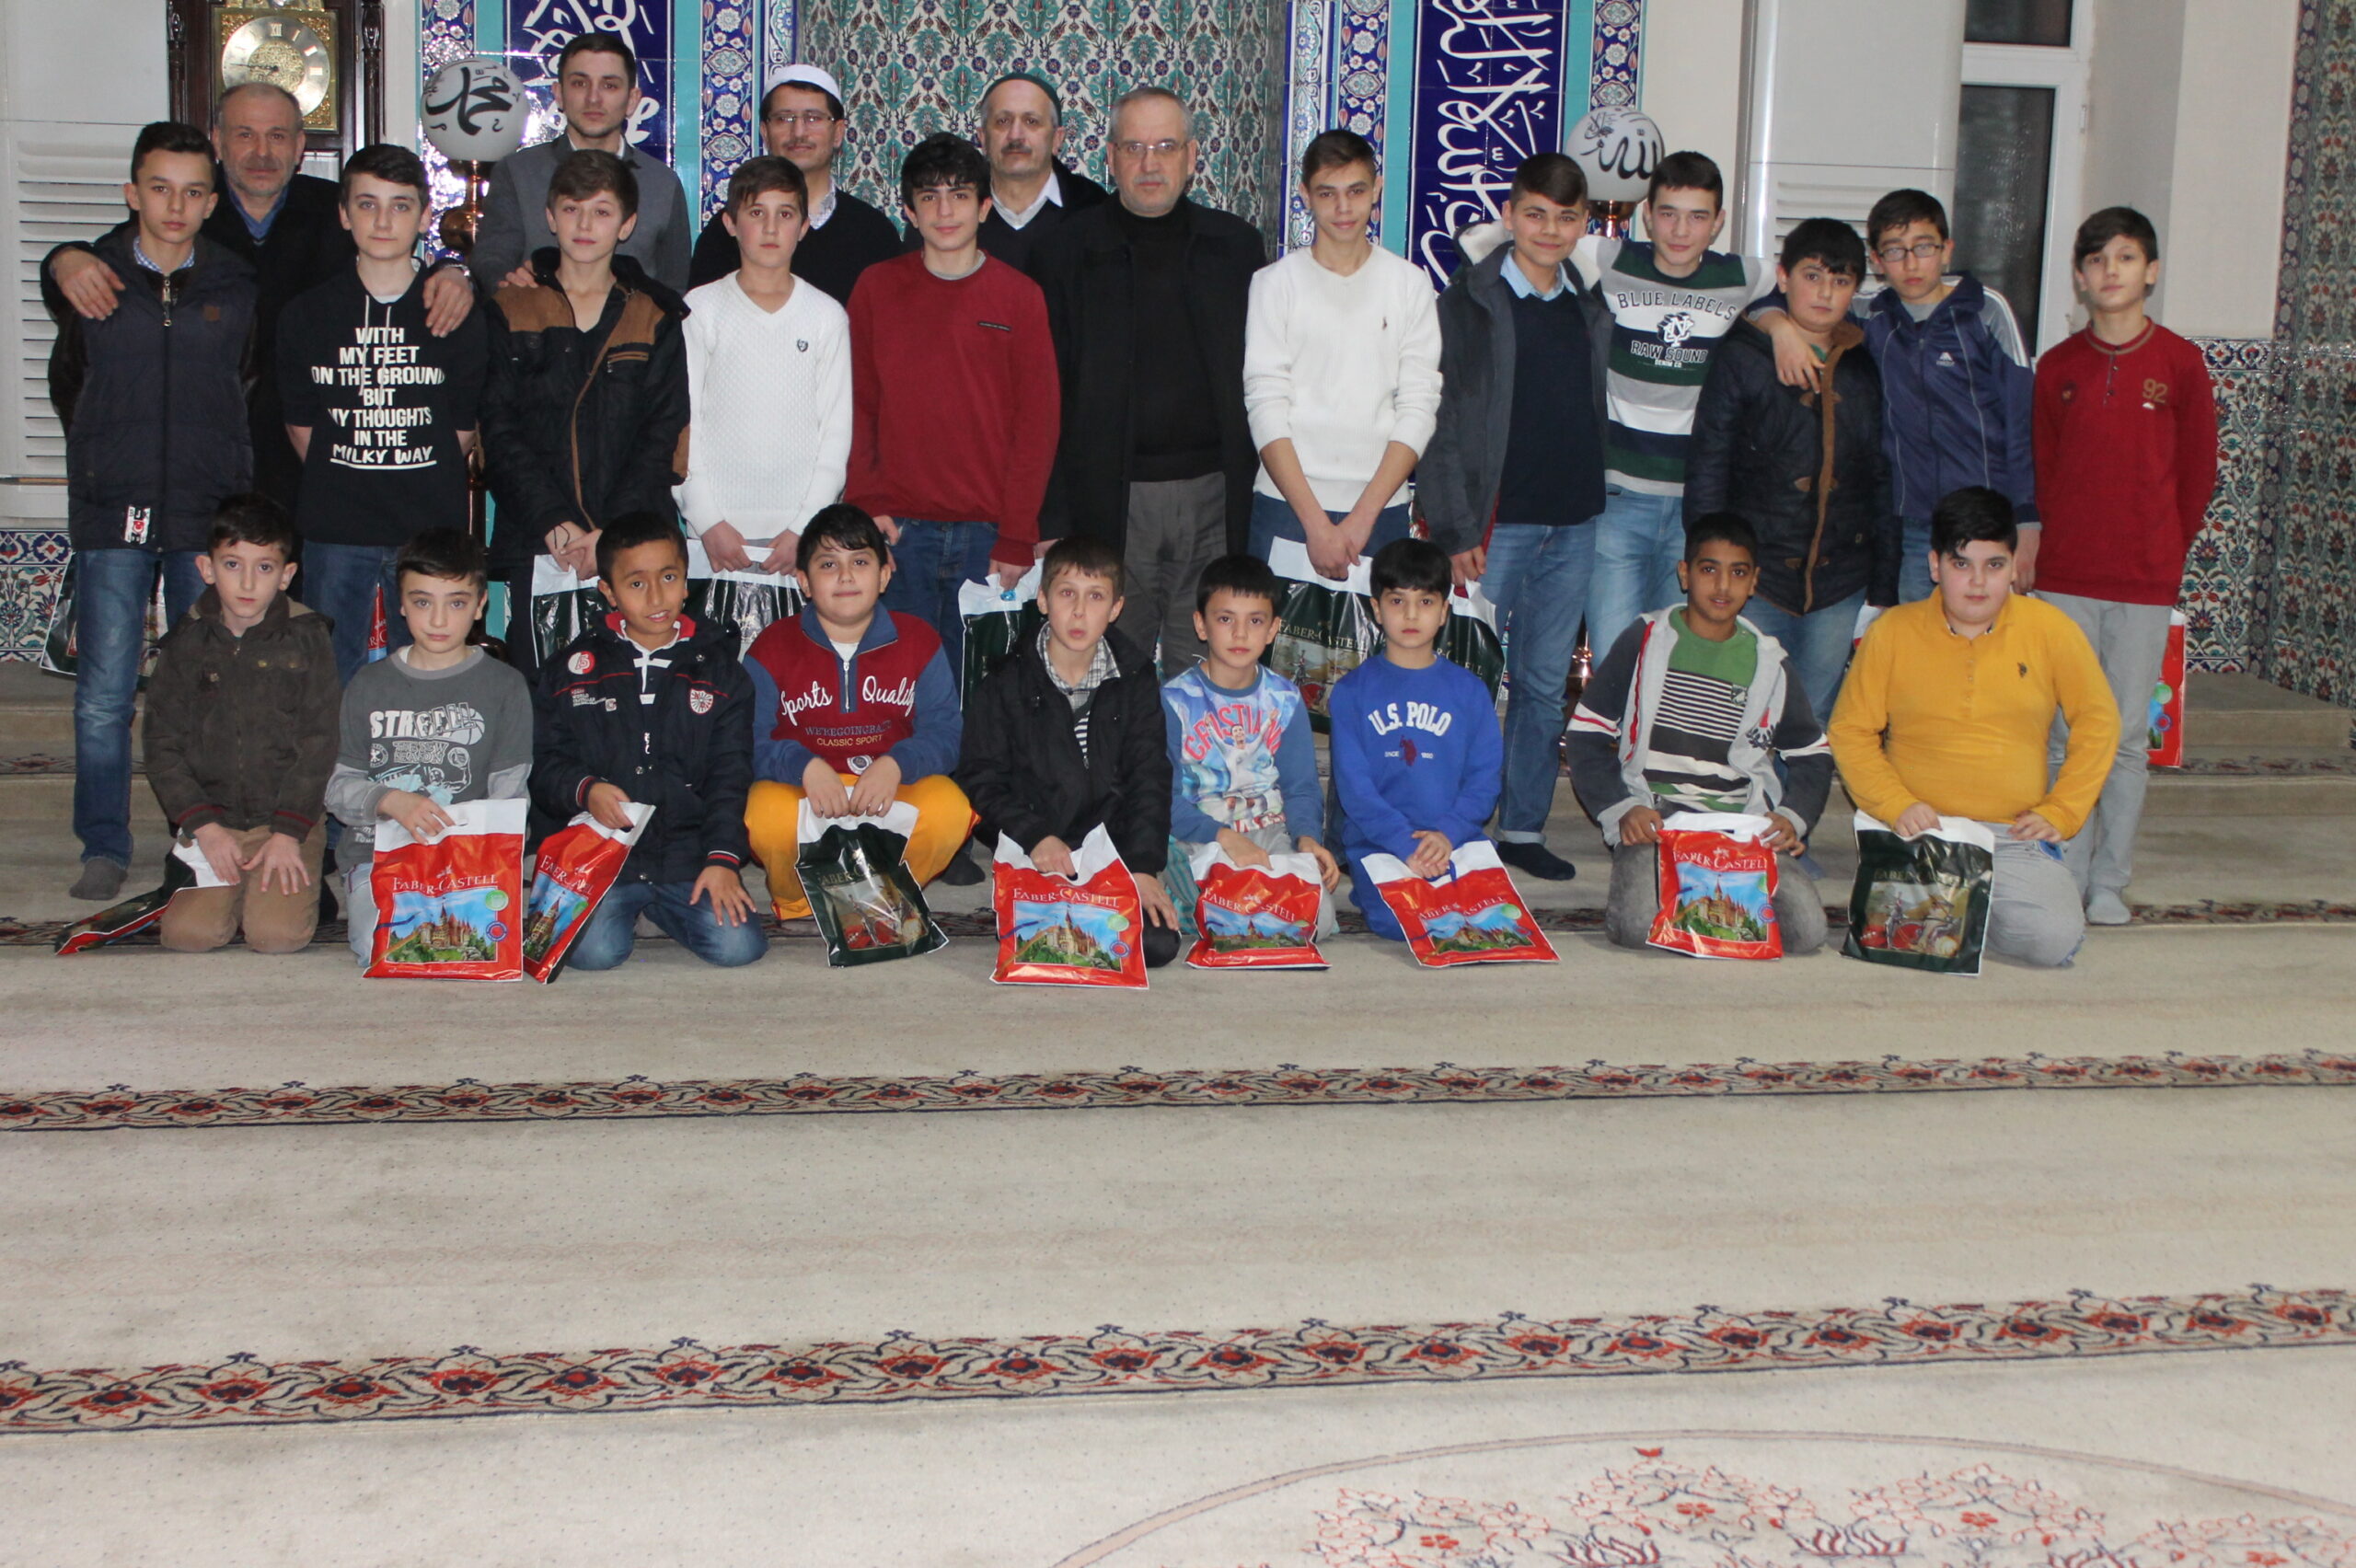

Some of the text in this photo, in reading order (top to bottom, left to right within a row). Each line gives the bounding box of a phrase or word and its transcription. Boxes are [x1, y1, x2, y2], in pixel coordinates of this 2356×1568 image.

[1617, 292, 1737, 320] BLUE LABELS
[355, 328, 405, 344] WITH
[340, 346, 421, 365] MY FEET
[1630, 340, 1709, 363] RAW SOUND
[311, 366, 445, 386] ON THE GROUND
[363, 388, 397, 407] BUT
[2142, 378, 2167, 403] 92
[352, 407, 433, 429] THOUGHTS
[353, 430, 408, 447] IN THE
[332, 444, 433, 465] MILKY WAY
[780, 675, 917, 726] Sports Quality
[1368, 701, 1452, 737] U.S. POLO
[816, 733, 883, 747] CLASSIC SPORT
[1012, 887, 1121, 908] FABER-CASTELL
